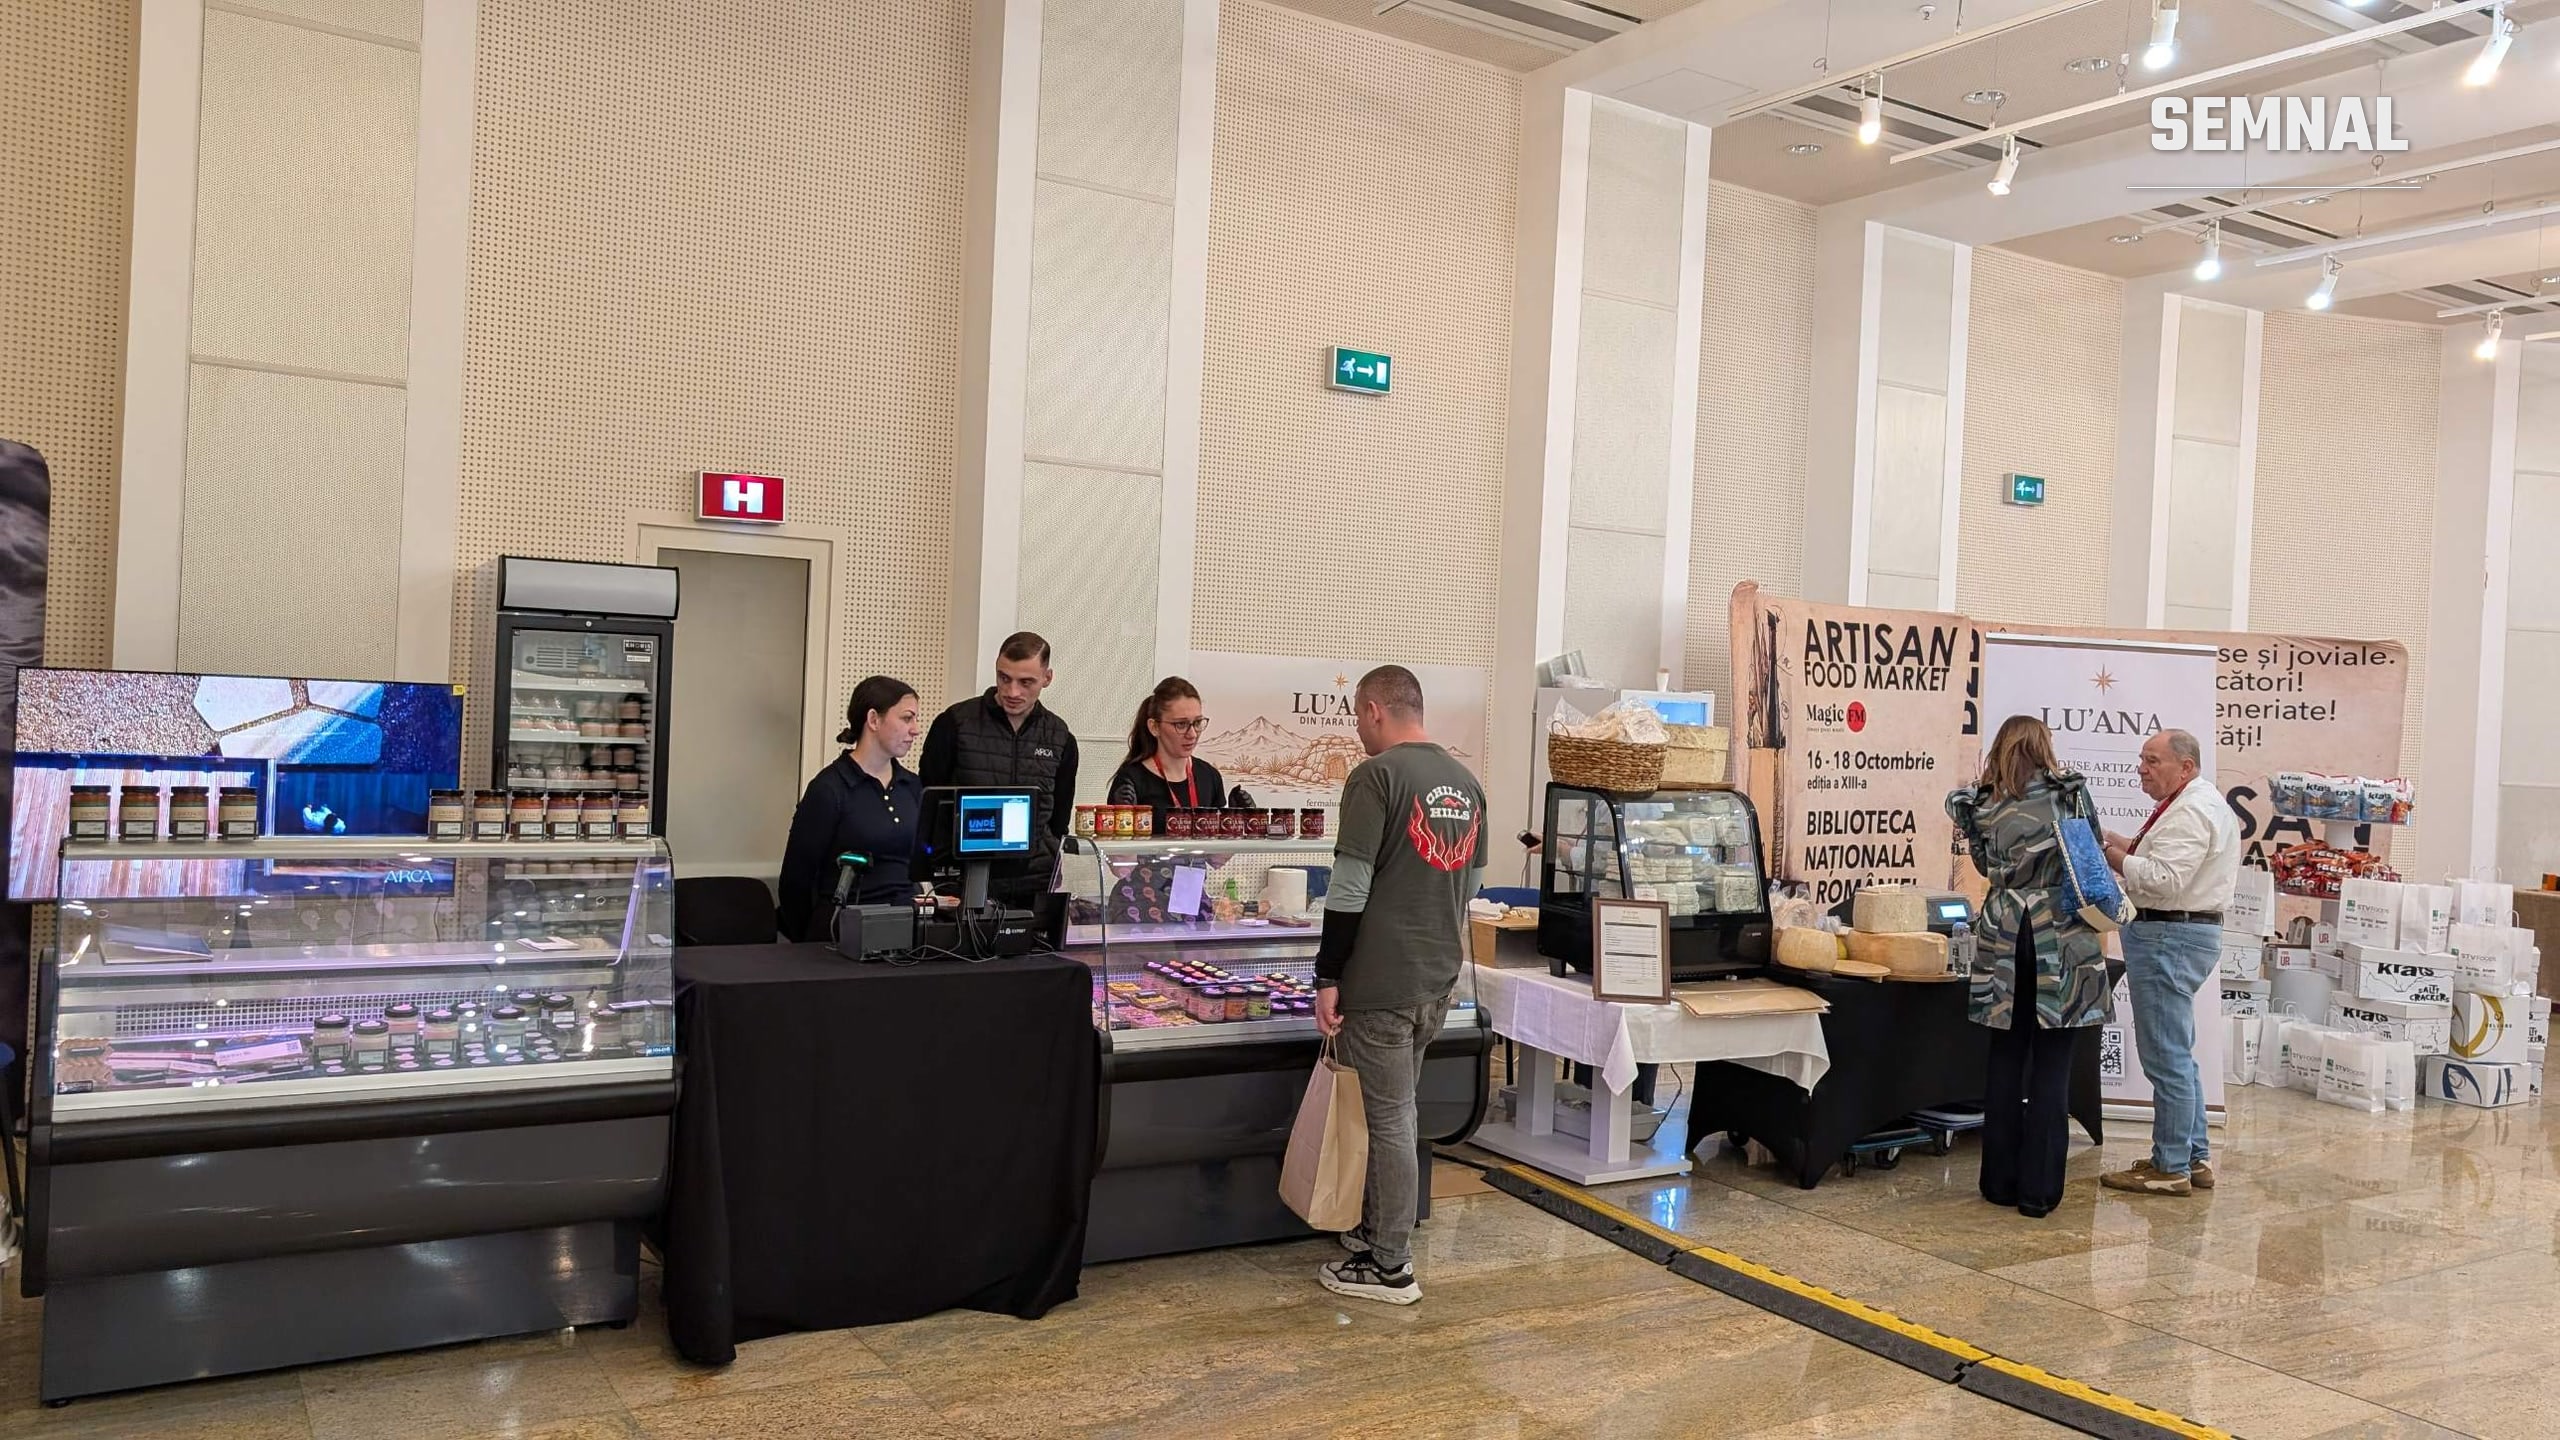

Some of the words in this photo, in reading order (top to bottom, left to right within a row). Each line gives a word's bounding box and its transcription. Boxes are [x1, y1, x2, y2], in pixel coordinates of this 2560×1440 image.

[723, 480, 764, 513] H
[1804, 618, 1958, 667] ARTISAN
[2218, 647, 2248, 663] se
[2257, 644, 2278, 670] și
[2286, 645, 2395, 671] joviale.
[1804, 661, 1857, 688] FOOD
[1863, 665, 1950, 691] MARKET
[2216, 669, 2303, 693] cători!
[1292, 692, 1358, 716] LU'A
[1806, 703, 1844, 727] Magic
[1847, 709, 1865, 723] FM
[2216, 699, 2336, 721] eneriate!
[1300, 716, 1316, 725] DIN
[2041, 707, 2163, 735] LU'ANA
[1807, 750, 1822, 770] 16
[1833, 750, 1850, 770] 18
[1854, 751, 1934, 770] Octombrie
[2057, 760, 2091, 771] DUSE
[1807, 776, 1831, 793] ediția
[1833, 779, 1839, 789] a
[1841, 776, 1867, 789] XIII-a
[2087, 777, 2104, 786] TE
[2108, 778, 2125, 787] DE
[1426, 785, 1471, 808] CHILLY
[1430, 807, 1471, 820] HILLS
[1807, 810, 1917, 835] BIBLIOTECA
[1804, 837, 1915, 877] NAȚIONALĂ
[384, 869, 434, 884] ARCA
[2409, 993, 2450, 1003] CRACKERS
